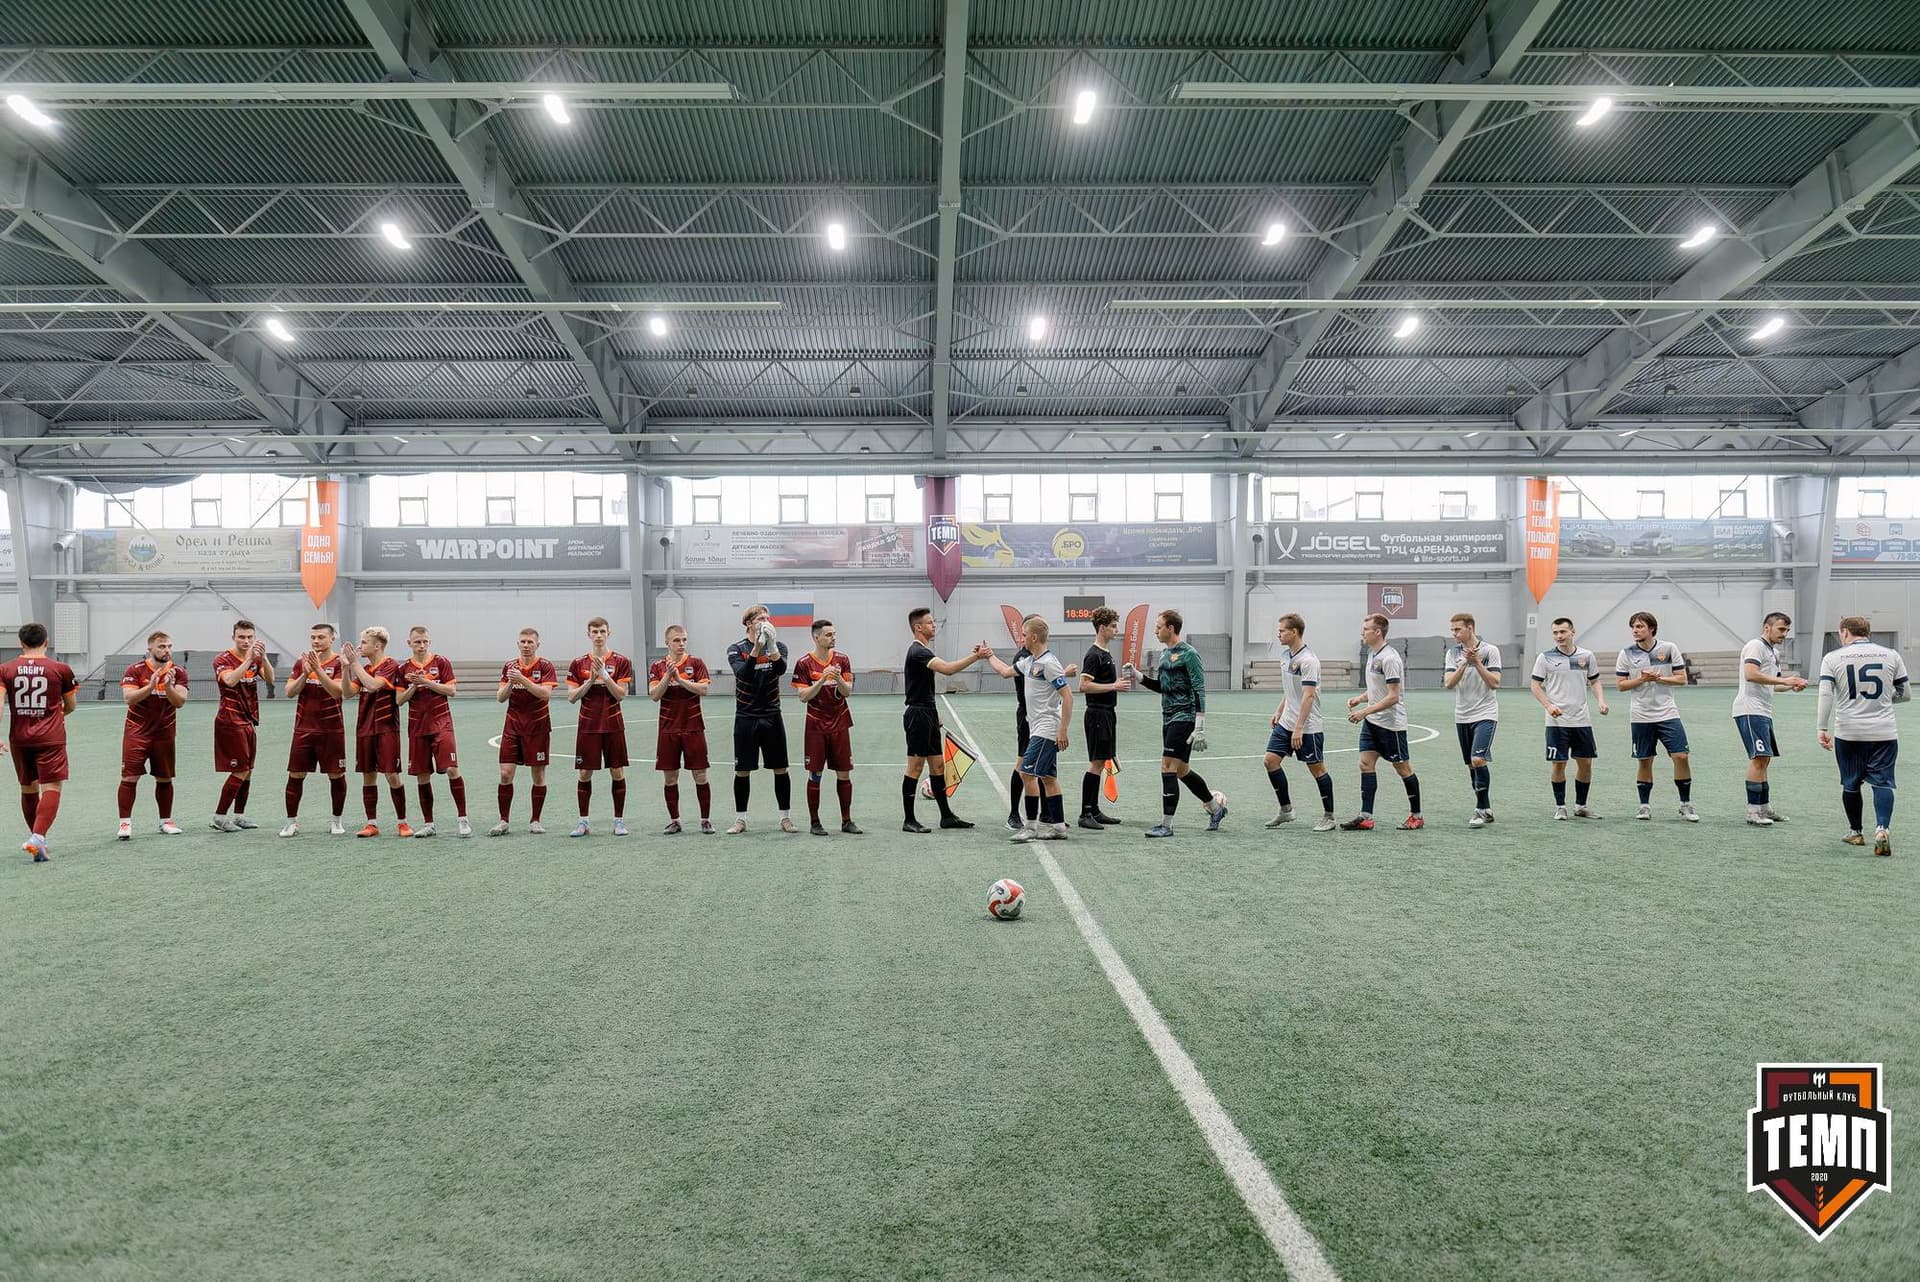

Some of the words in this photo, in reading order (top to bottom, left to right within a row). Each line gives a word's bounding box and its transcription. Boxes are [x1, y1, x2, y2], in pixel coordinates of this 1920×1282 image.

[931, 526, 957, 541] ТЕМП
[1380, 533, 1442, 545] Футбольная
[1444, 534, 1504, 545] экипировка
[1528, 531, 1556, 545] ТОЛЬКО
[175, 534, 208, 550] Орел
[213, 537, 221, 547] и
[228, 534, 272, 547] Решка
[307, 535, 331, 549] ОДНА
[1301, 532, 1381, 551] JÖGEL
[416, 538, 560, 560] WARPOINT
[1385, 545, 1407, 556] ТРЦ
[1409, 544, 1462, 555] «АРЕНА»,
[1463, 545, 1471, 554] 3
[1472, 546, 1498, 554] этаж
[304, 551, 334, 564] СЕМЬЯ!
[1846, 663, 1883, 700] 15
[14, 676, 48, 708] 22
[1756, 739, 1765, 752] 6
